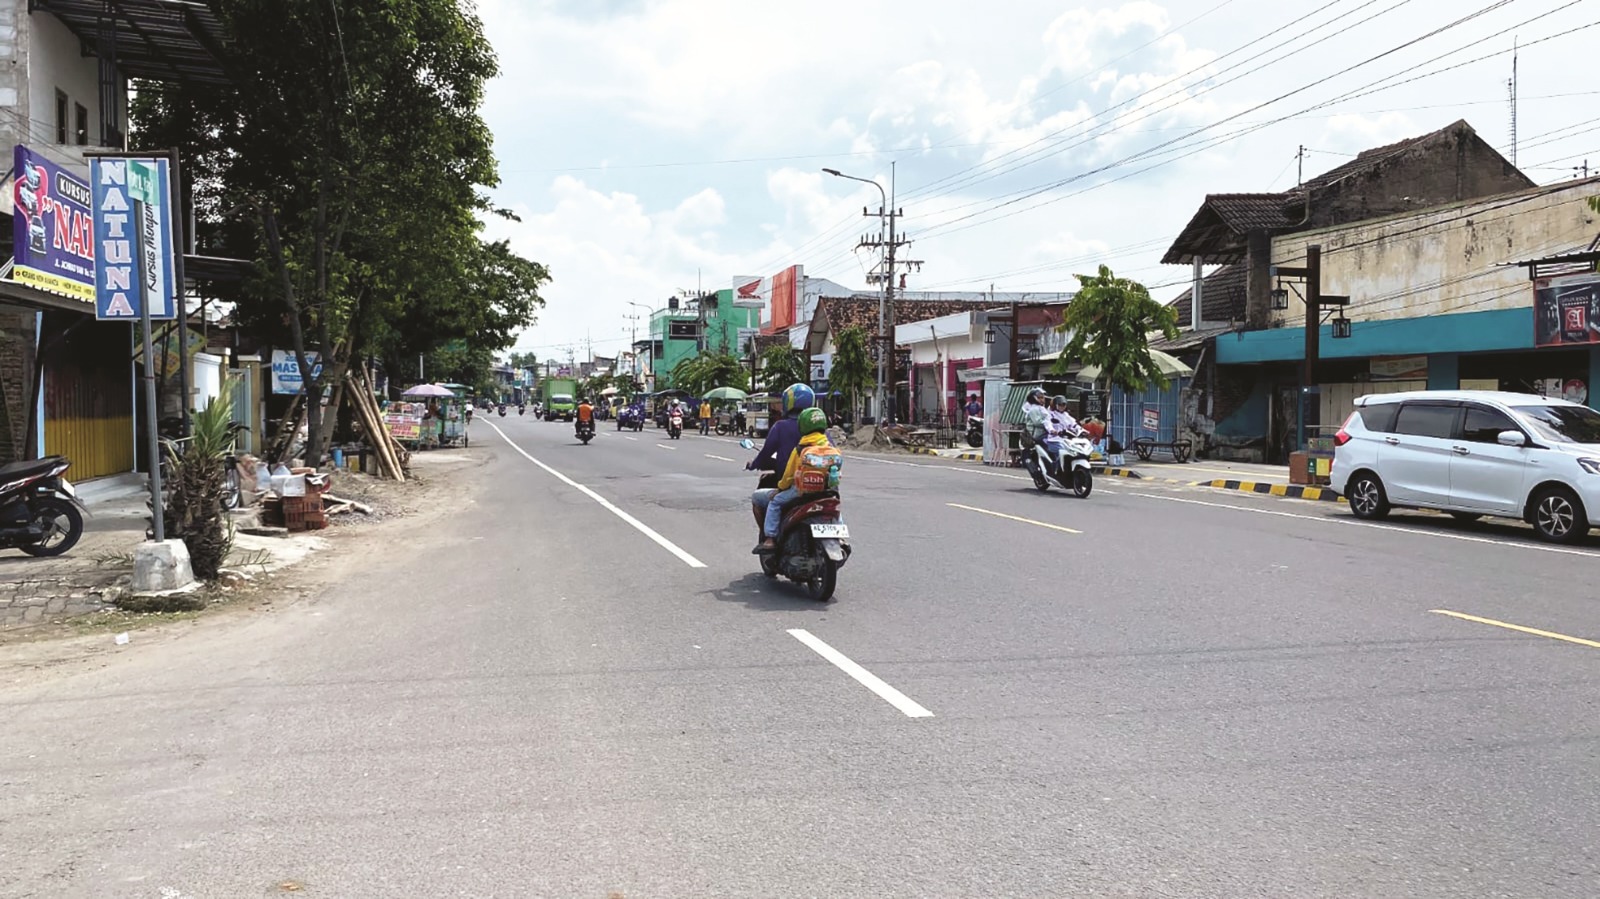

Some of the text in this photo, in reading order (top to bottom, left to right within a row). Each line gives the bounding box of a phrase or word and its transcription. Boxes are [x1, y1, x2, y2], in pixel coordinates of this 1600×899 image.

[59, 177, 91, 205] KURSUS
[100, 161, 135, 316] NATUNA
[144, 202, 159, 293] Kursus Mengem
[272, 362, 298, 373] MAS
